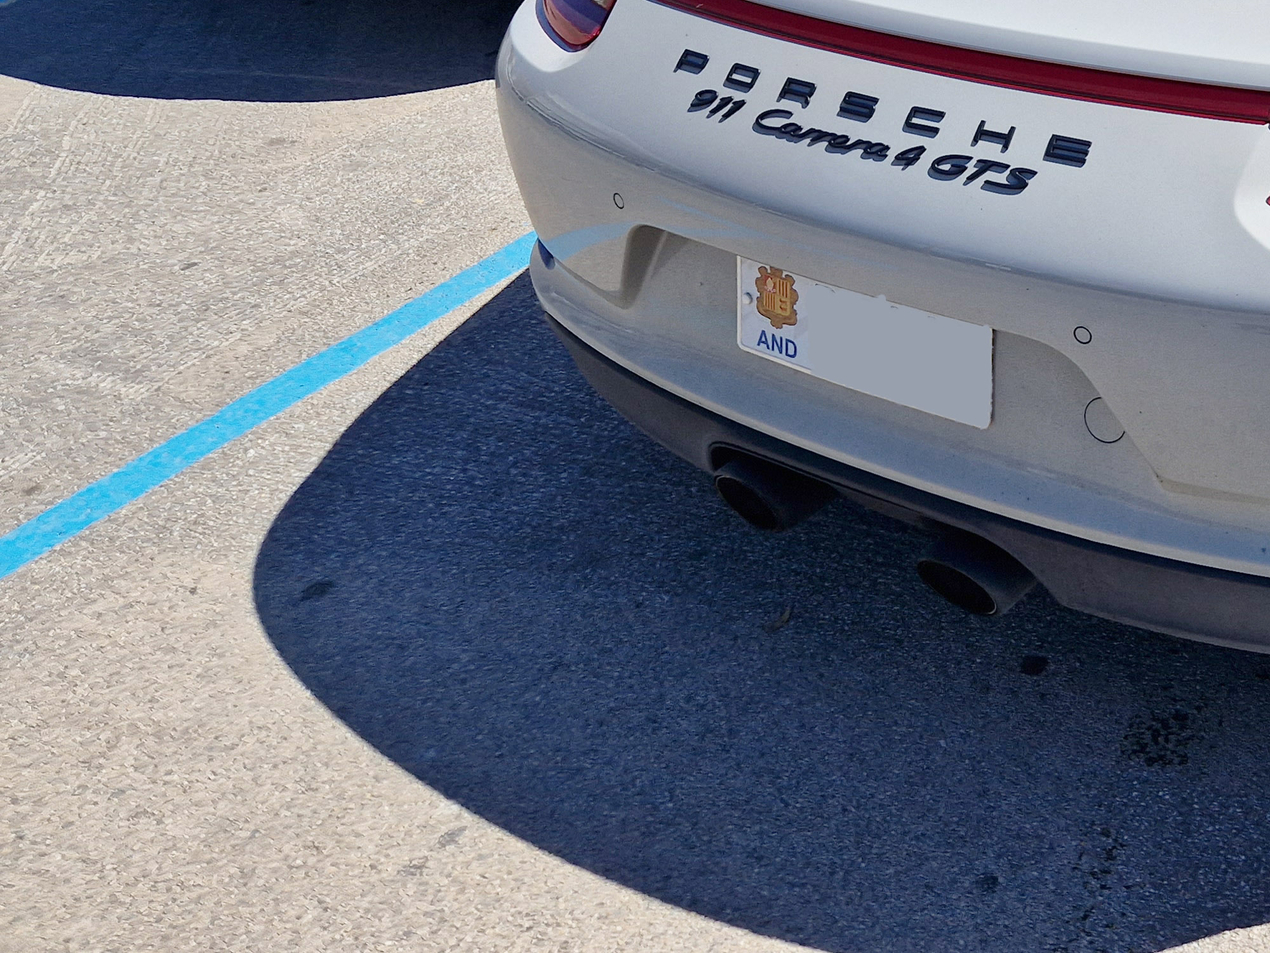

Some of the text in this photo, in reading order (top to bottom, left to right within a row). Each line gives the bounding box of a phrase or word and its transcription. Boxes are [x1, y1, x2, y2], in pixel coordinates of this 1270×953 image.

[673, 48, 1093, 168] PORSCHE
[687, 89, 1038, 196] 911 Carrera 4 GTS
[757, 329, 798, 359] AND
